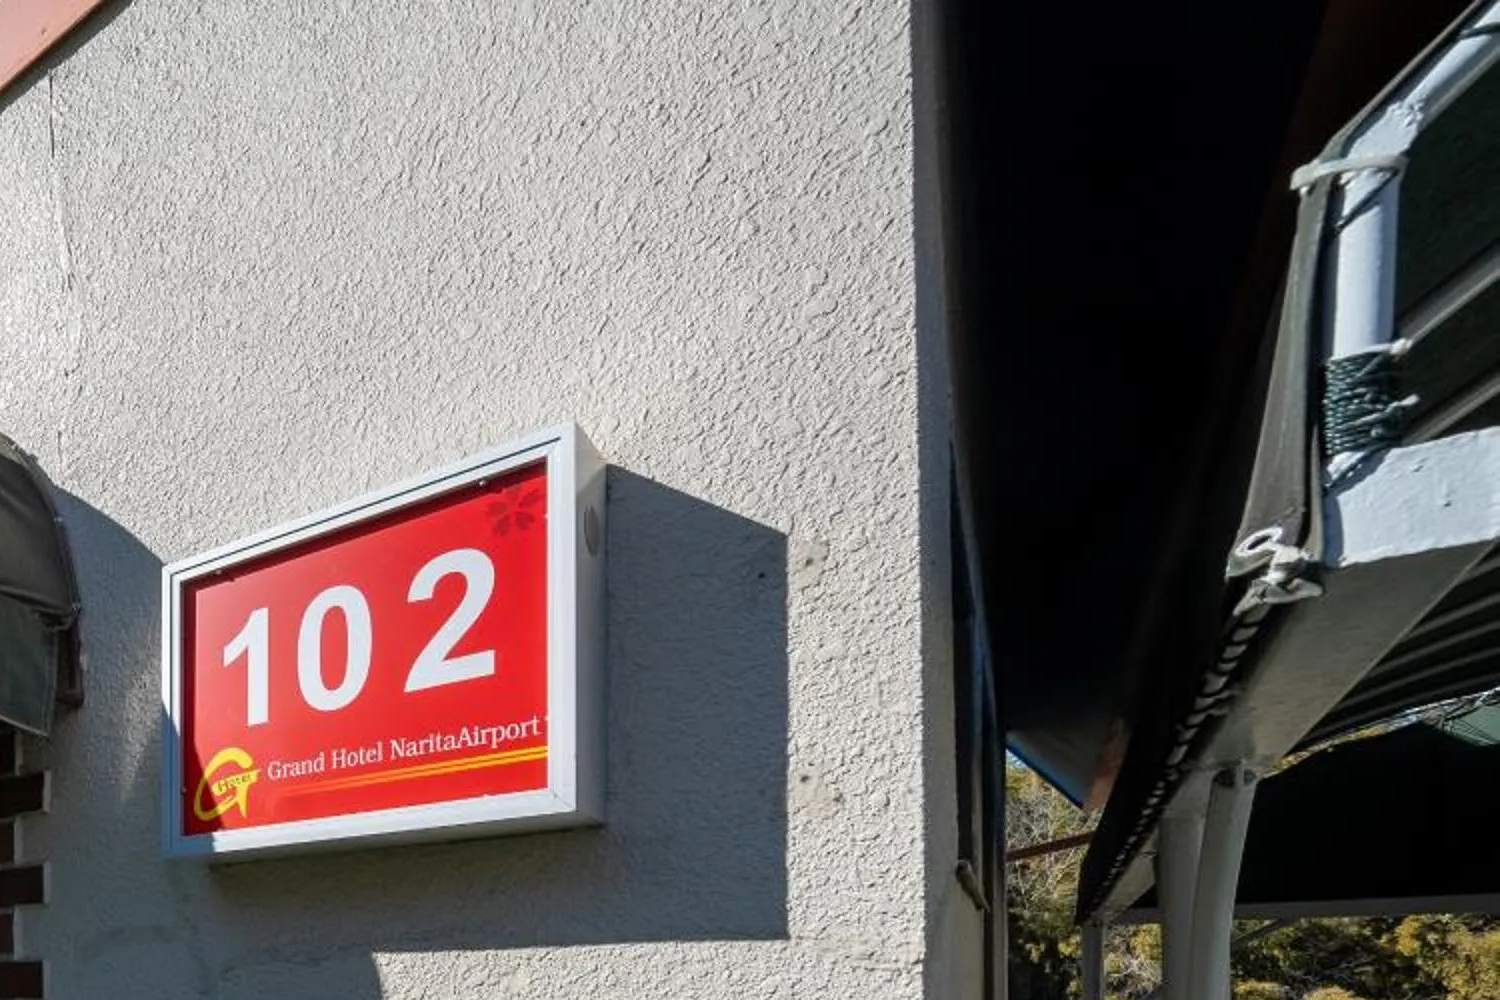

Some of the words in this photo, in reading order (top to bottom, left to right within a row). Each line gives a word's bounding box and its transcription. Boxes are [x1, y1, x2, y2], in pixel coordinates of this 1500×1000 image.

[222, 547, 496, 728] 102
[267, 752, 325, 780] Grand
[331, 741, 384, 770] Hotel
[390, 714, 541, 760] NaritaAirport
